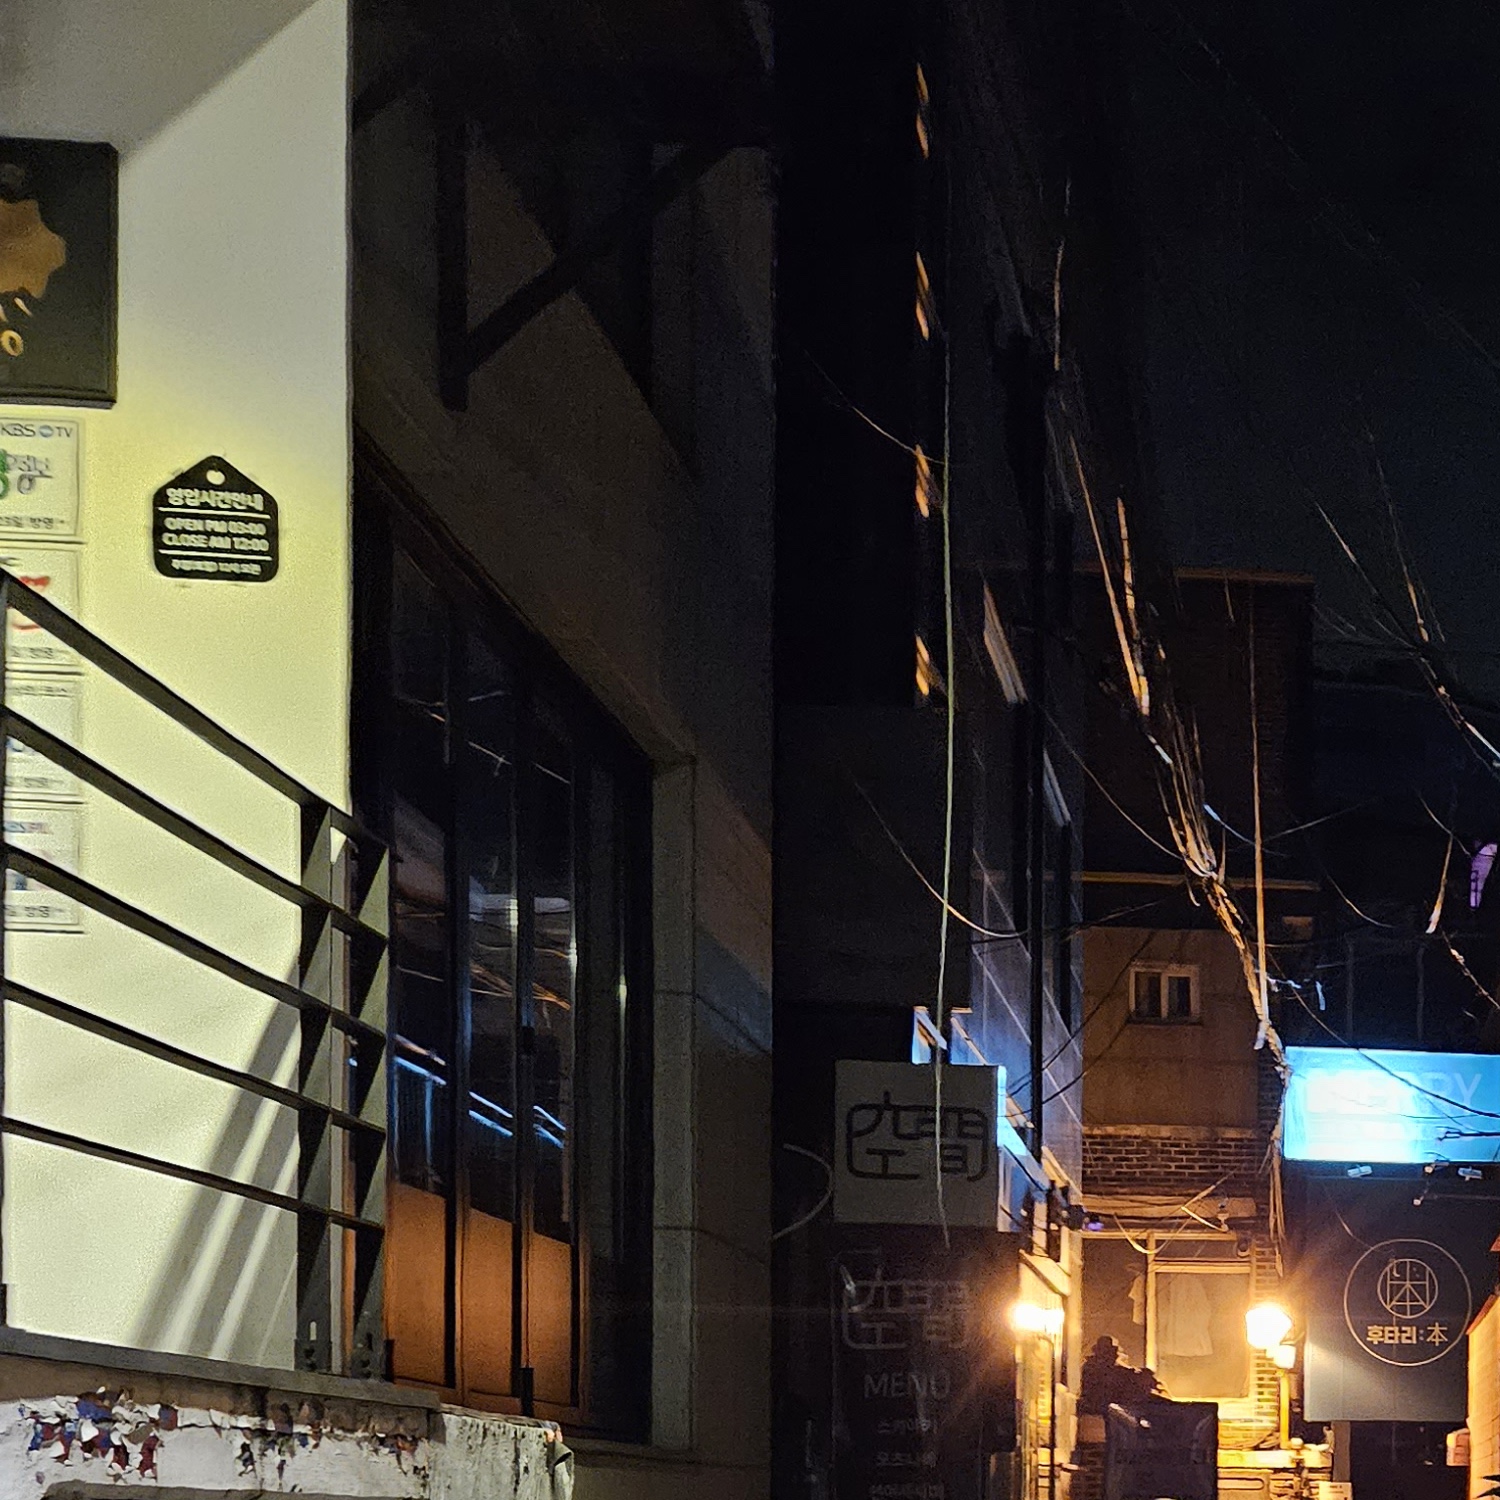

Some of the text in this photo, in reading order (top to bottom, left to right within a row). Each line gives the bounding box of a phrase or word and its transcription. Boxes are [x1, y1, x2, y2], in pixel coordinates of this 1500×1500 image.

[55, 425, 73, 438] TV
[164, 517, 205, 531] OPEN
[205, 519, 228, 533] PM
[162, 532, 209, 547] CLOSE
[863, 1369, 951, 1399] MENU
